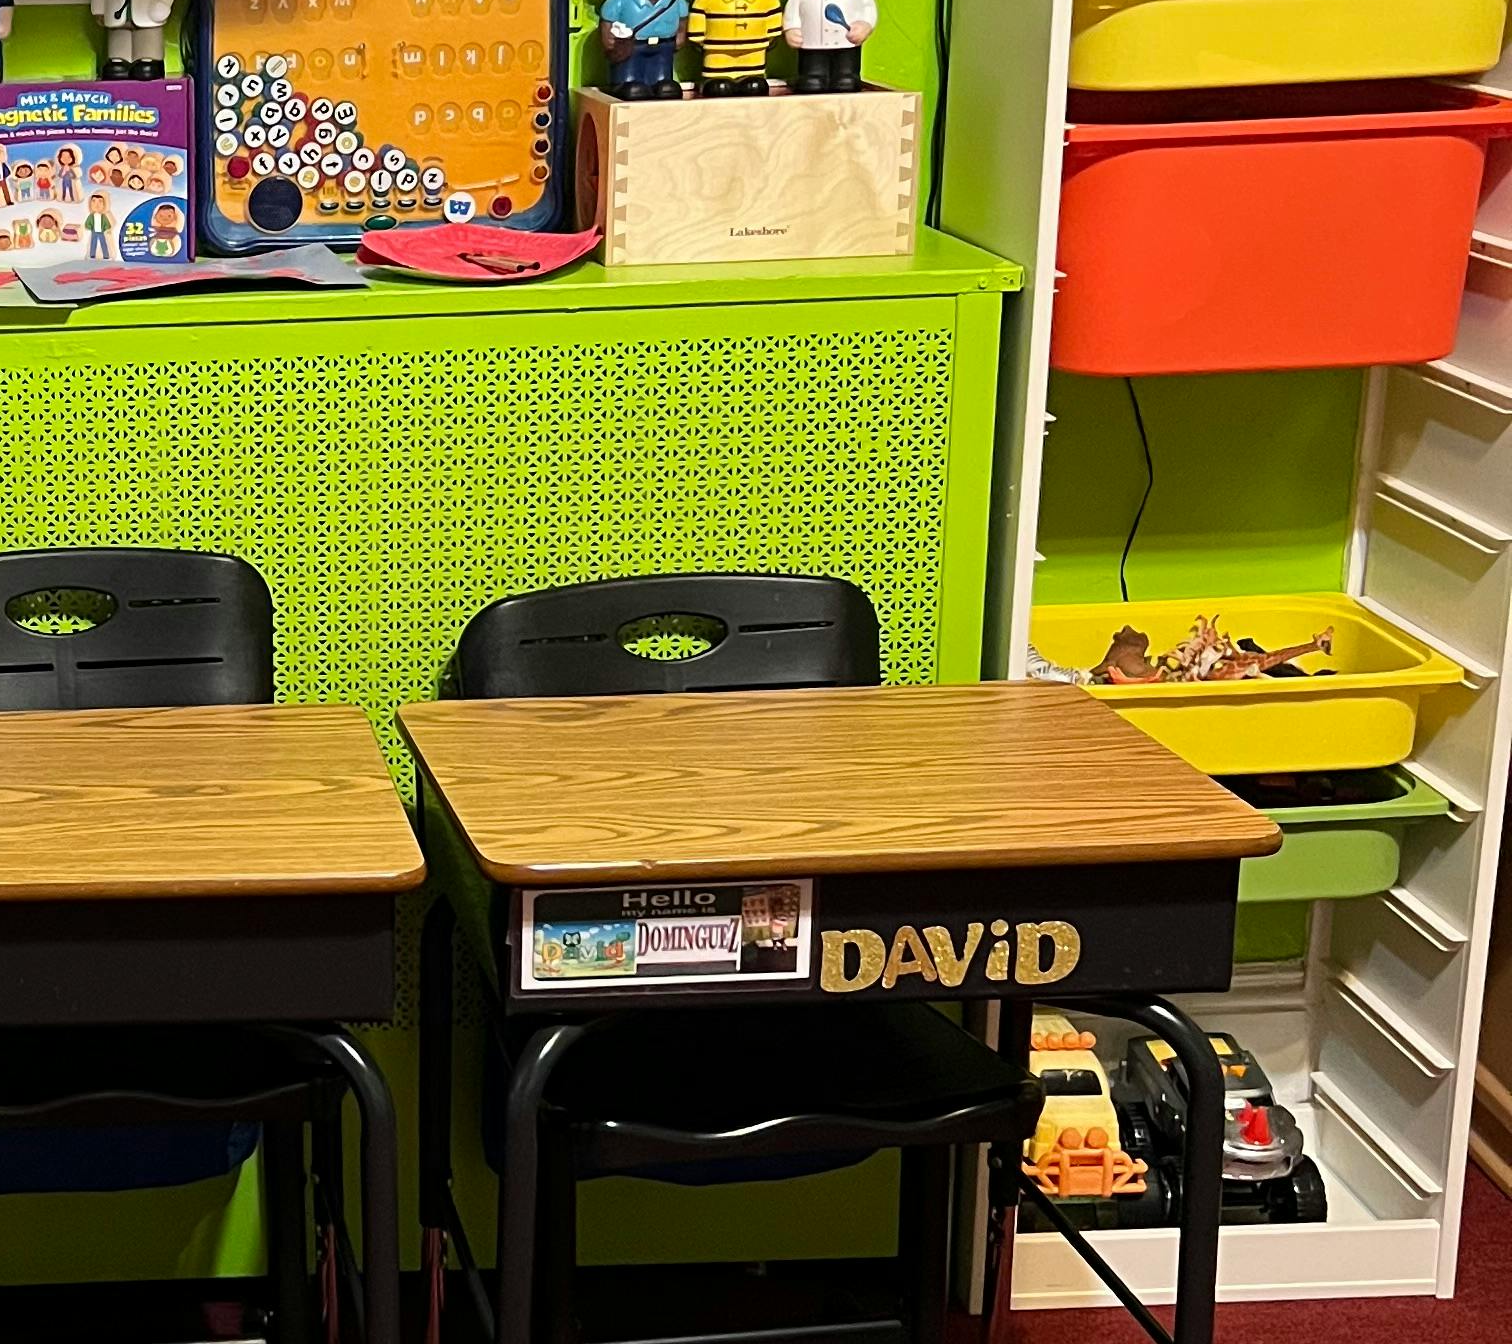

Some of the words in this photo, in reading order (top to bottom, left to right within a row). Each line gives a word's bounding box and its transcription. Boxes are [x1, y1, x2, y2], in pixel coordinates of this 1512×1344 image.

[20, 93, 47, 106] MIX
[50, 92, 58, 103] &
[61, 92, 109, 105] MATCH
[73, 104, 156, 124] Families
[250, 130, 261, 142] x
[389, 153, 400, 165] s
[125, 222, 144, 235] 32
[729, 226, 787, 236] Lakeshore
[622, 890, 716, 907] Hello
[622, 909, 647, 918] my
[651, 907, 696, 916] name
[702, 906, 716, 914] is
[638, 918, 741, 956] DOMINGUEZ
